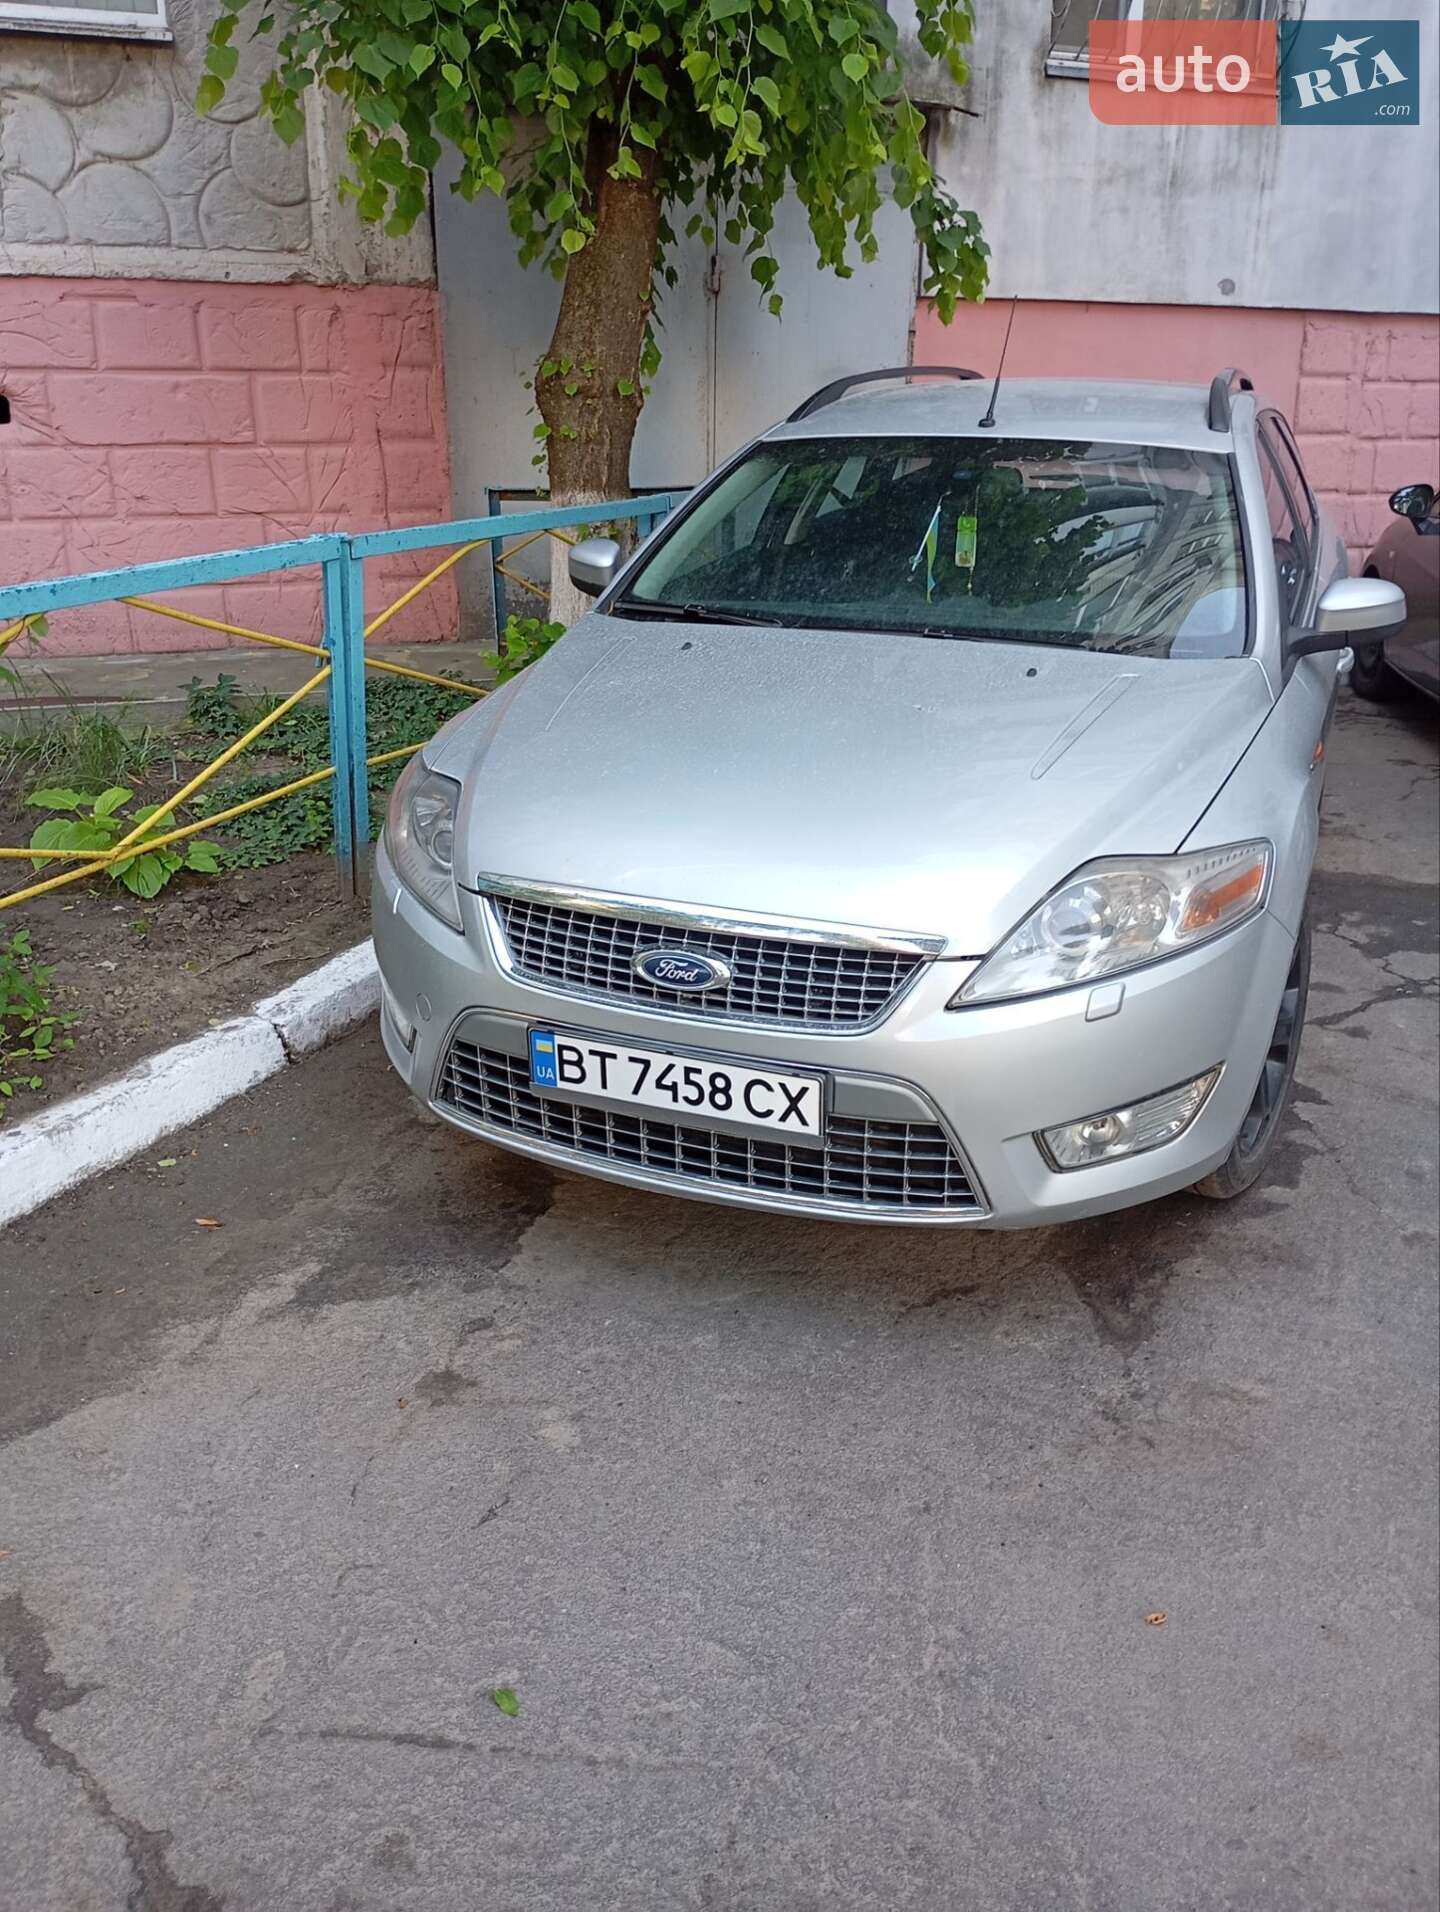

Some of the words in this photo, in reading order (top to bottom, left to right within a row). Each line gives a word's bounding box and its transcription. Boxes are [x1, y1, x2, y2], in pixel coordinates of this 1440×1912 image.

[655, 958, 701, 983] Ford
[536, 1065, 554, 1081] UA
[557, 1043, 617, 1090] BT
[628, 1055, 732, 1111] 7458
[743, 1078, 810, 1127] CX
